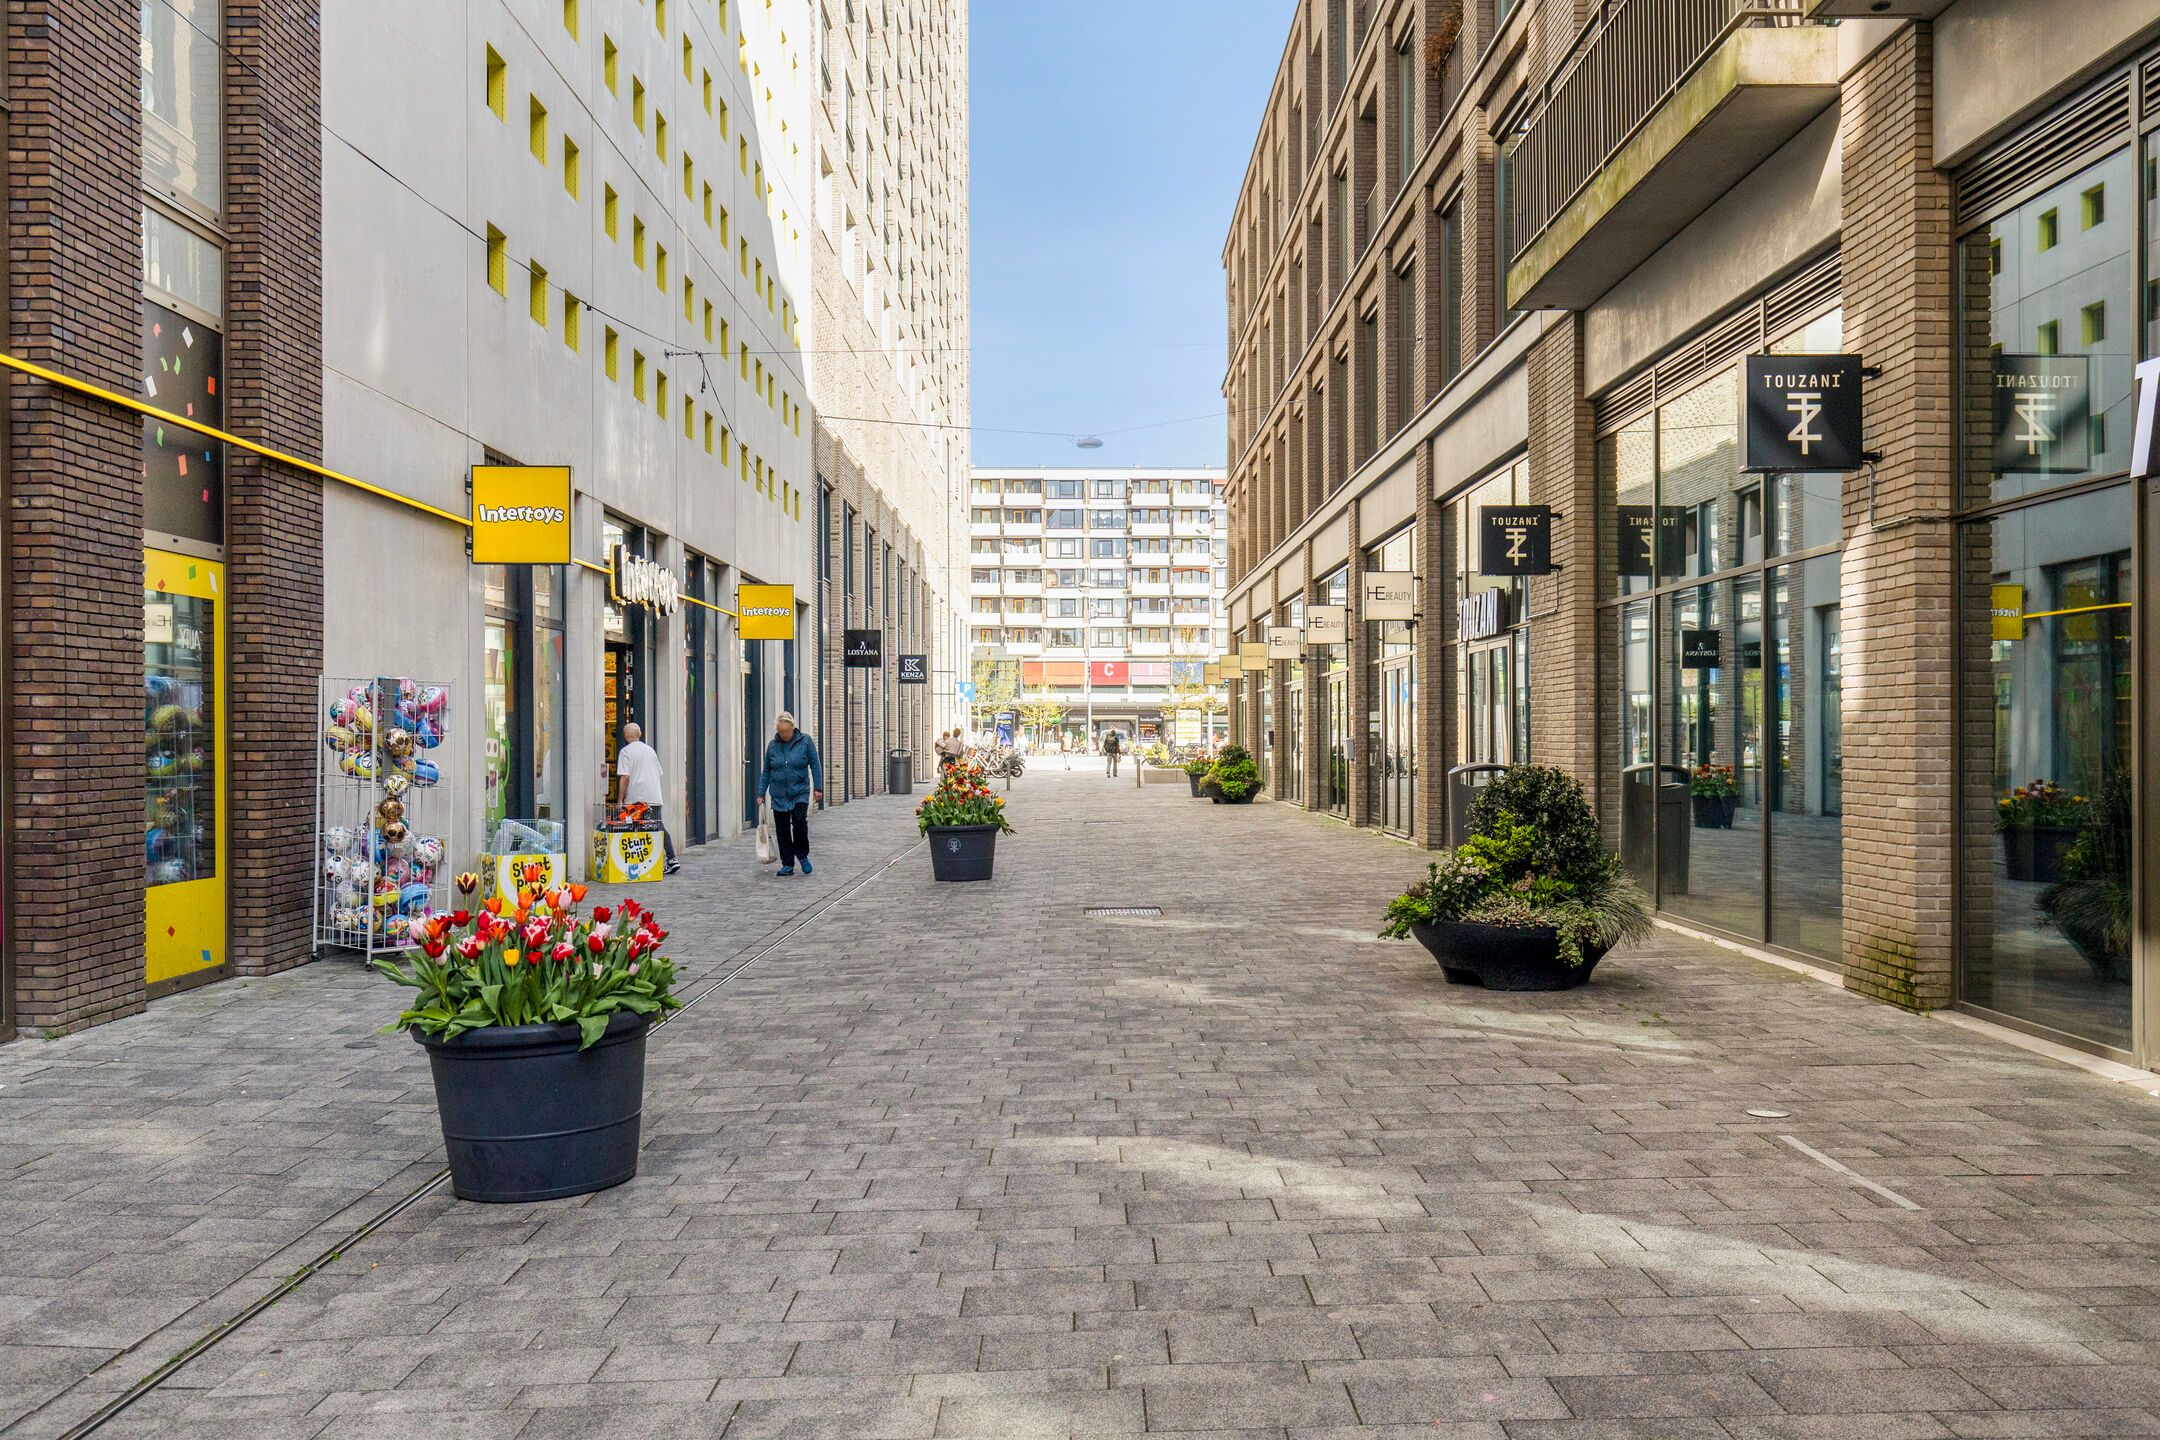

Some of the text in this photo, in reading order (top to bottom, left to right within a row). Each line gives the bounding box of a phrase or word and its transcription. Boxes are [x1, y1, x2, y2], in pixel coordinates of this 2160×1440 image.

[1764, 374, 1840, 388] TOUZANI
[478, 504, 565, 524] Intertoys
[1491, 517, 1538, 526] TOUZANI
[1386, 592, 1411, 601] BEAUTY
[742, 605, 790, 616] Intertoys
[621, 834, 652, 851] Stunt
[624, 847, 649, 864] prijs
